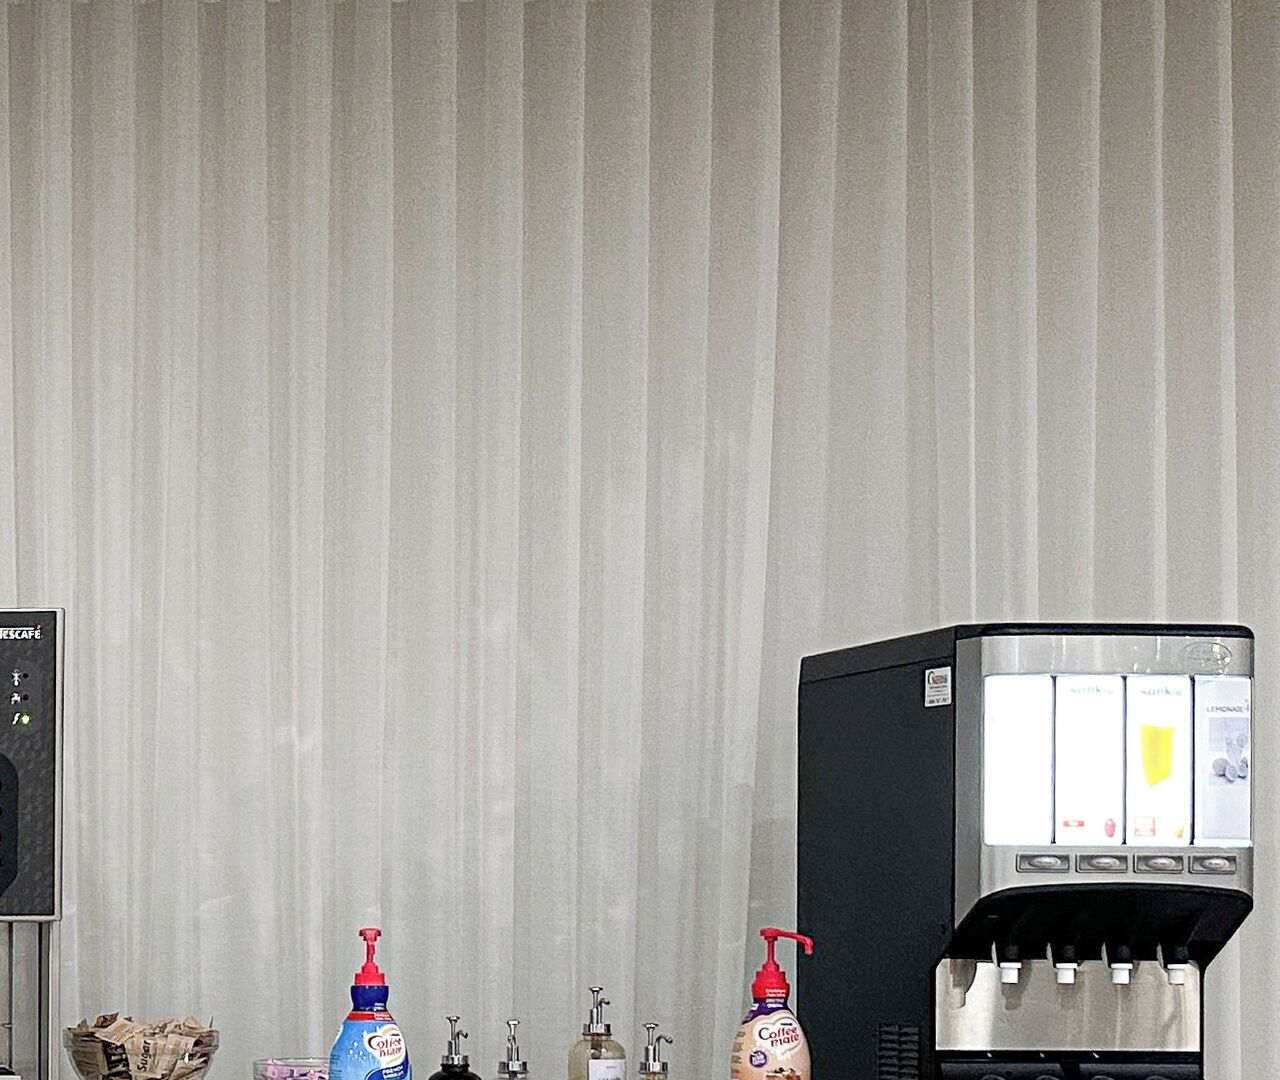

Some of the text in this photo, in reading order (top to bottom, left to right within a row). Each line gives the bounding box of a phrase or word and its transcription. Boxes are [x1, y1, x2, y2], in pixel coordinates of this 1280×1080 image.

[758, 1027, 797, 1040] Coffee
[771, 1034, 799, 1047] mate
[137, 1040, 151, 1073] Sugar
